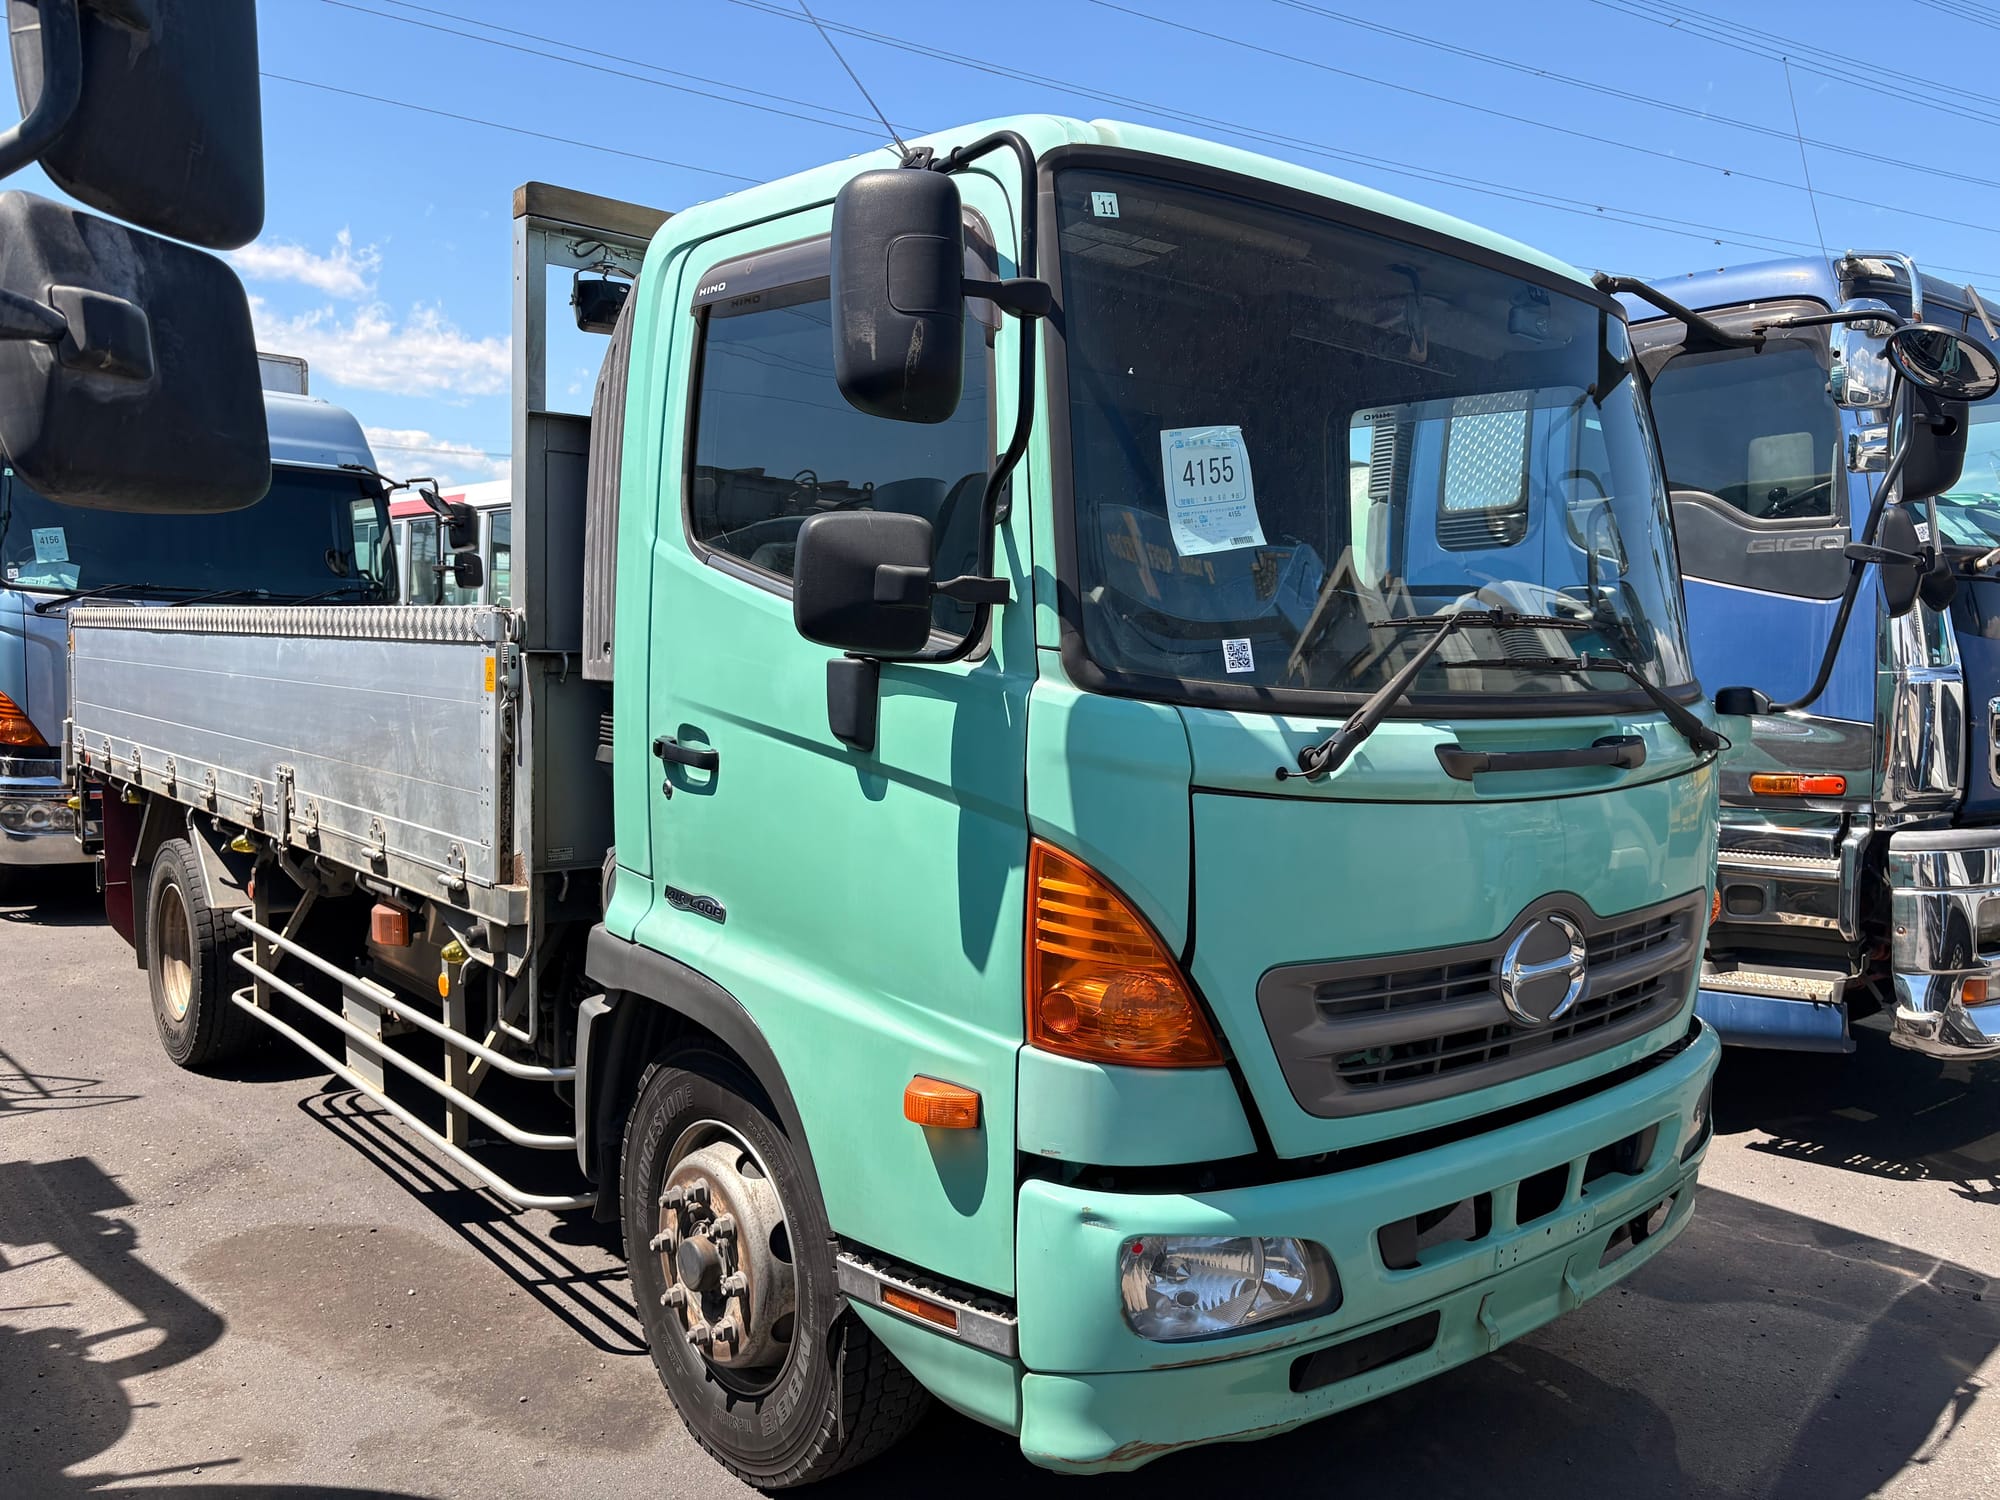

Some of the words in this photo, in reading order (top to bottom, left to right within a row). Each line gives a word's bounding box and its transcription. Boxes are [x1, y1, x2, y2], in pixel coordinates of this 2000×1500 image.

[1101, 200, 1115, 215] 11
[698, 282, 727, 297] HINO
[1182, 456, 1234, 487] 4155
[39, 535, 60, 545] 4156
